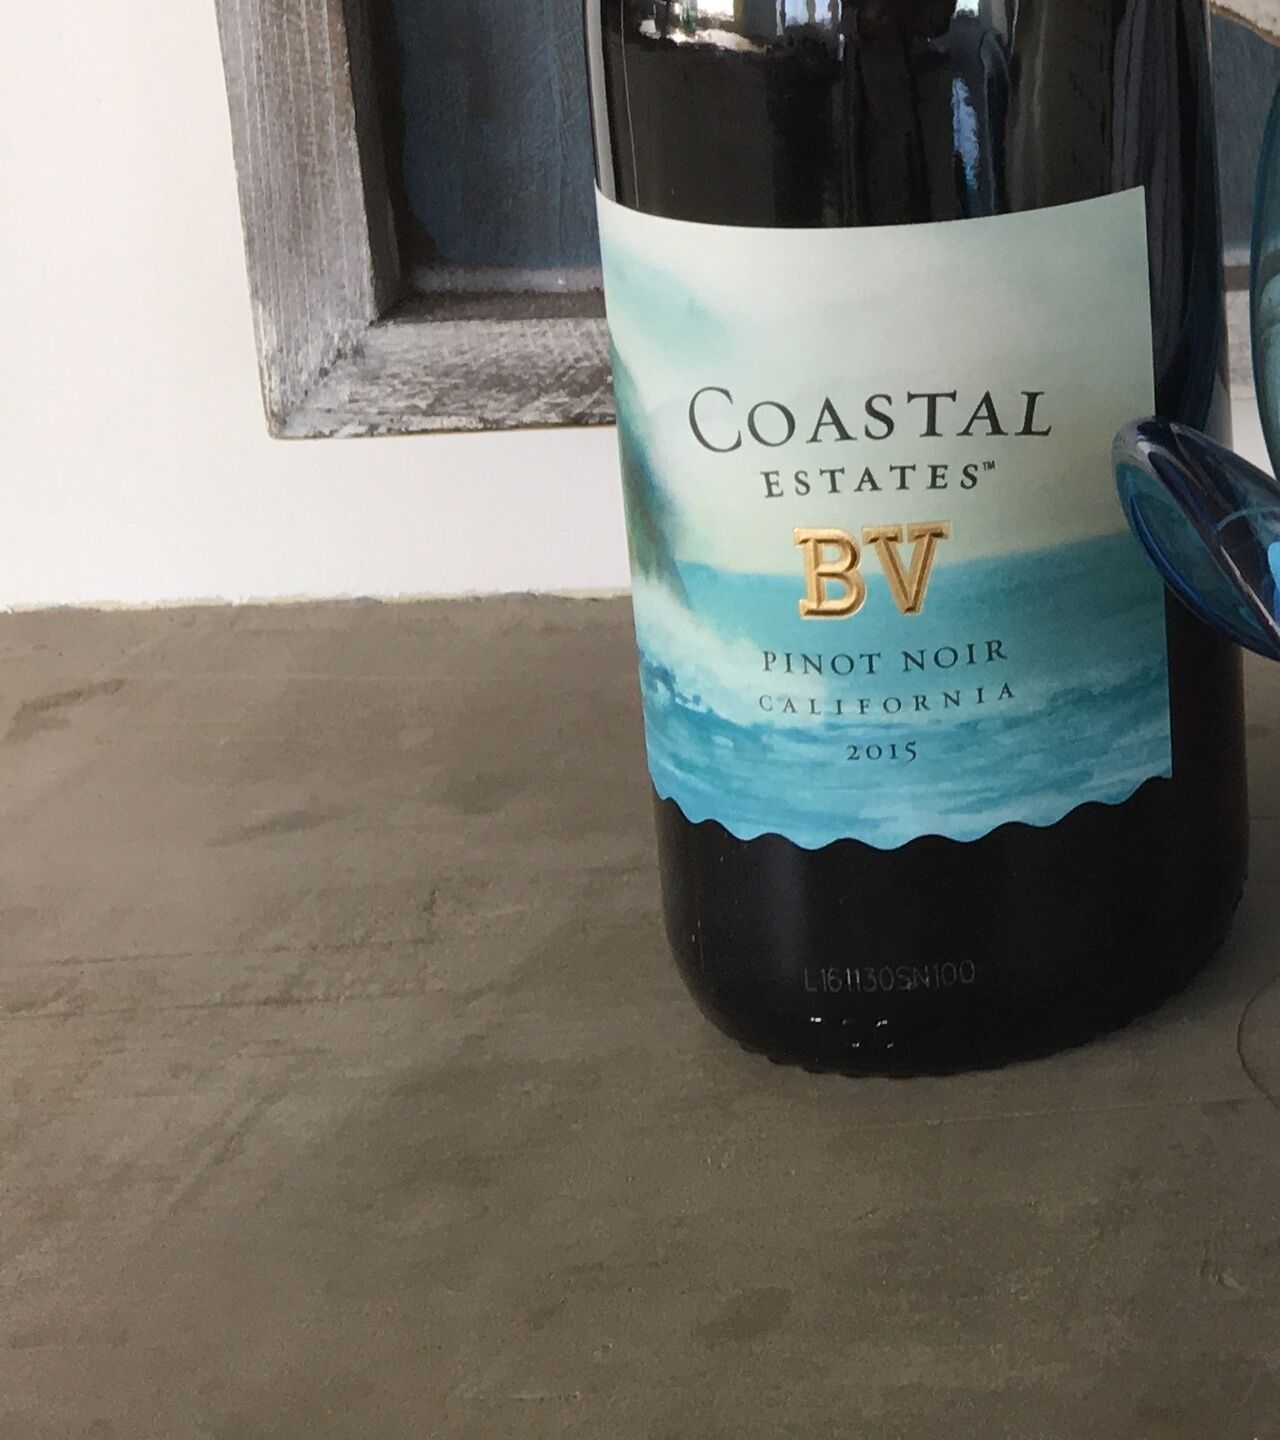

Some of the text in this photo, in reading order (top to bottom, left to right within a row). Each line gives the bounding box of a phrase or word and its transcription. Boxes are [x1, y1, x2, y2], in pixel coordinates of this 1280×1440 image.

[688, 385, 1053, 455] COASTAL
[793, 519, 951, 621] BV
[762, 639, 1008, 677] PINOT NOIR
[759, 682, 1016, 717] CALIFORNIA
[846, 739, 919, 764] 2015
